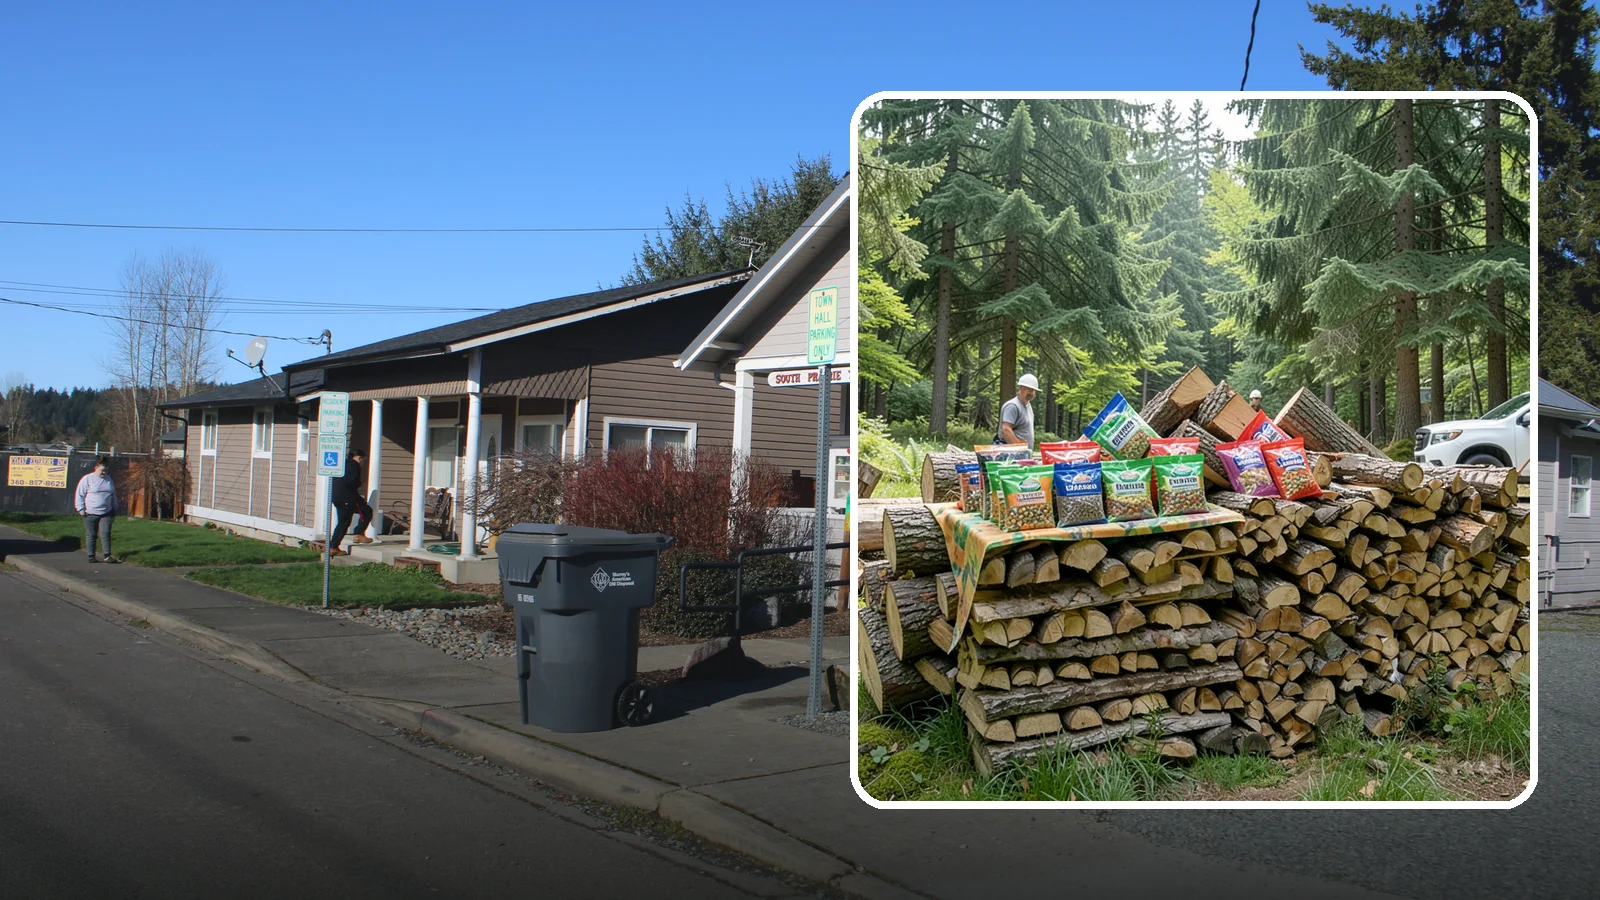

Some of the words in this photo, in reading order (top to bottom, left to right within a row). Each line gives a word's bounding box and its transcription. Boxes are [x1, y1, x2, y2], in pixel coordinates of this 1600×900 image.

[815, 294, 833, 308] TOWN
[814, 312, 831, 324] HALL
[810, 327, 835, 340] PARKING
[814, 344, 830, 357] ONLY
[775, 373, 801, 385] SOUTH
[808, 371, 841, 382] PRIE
[322, 409, 345, 417] PARKING
[325, 420, 340, 428] ONLY
